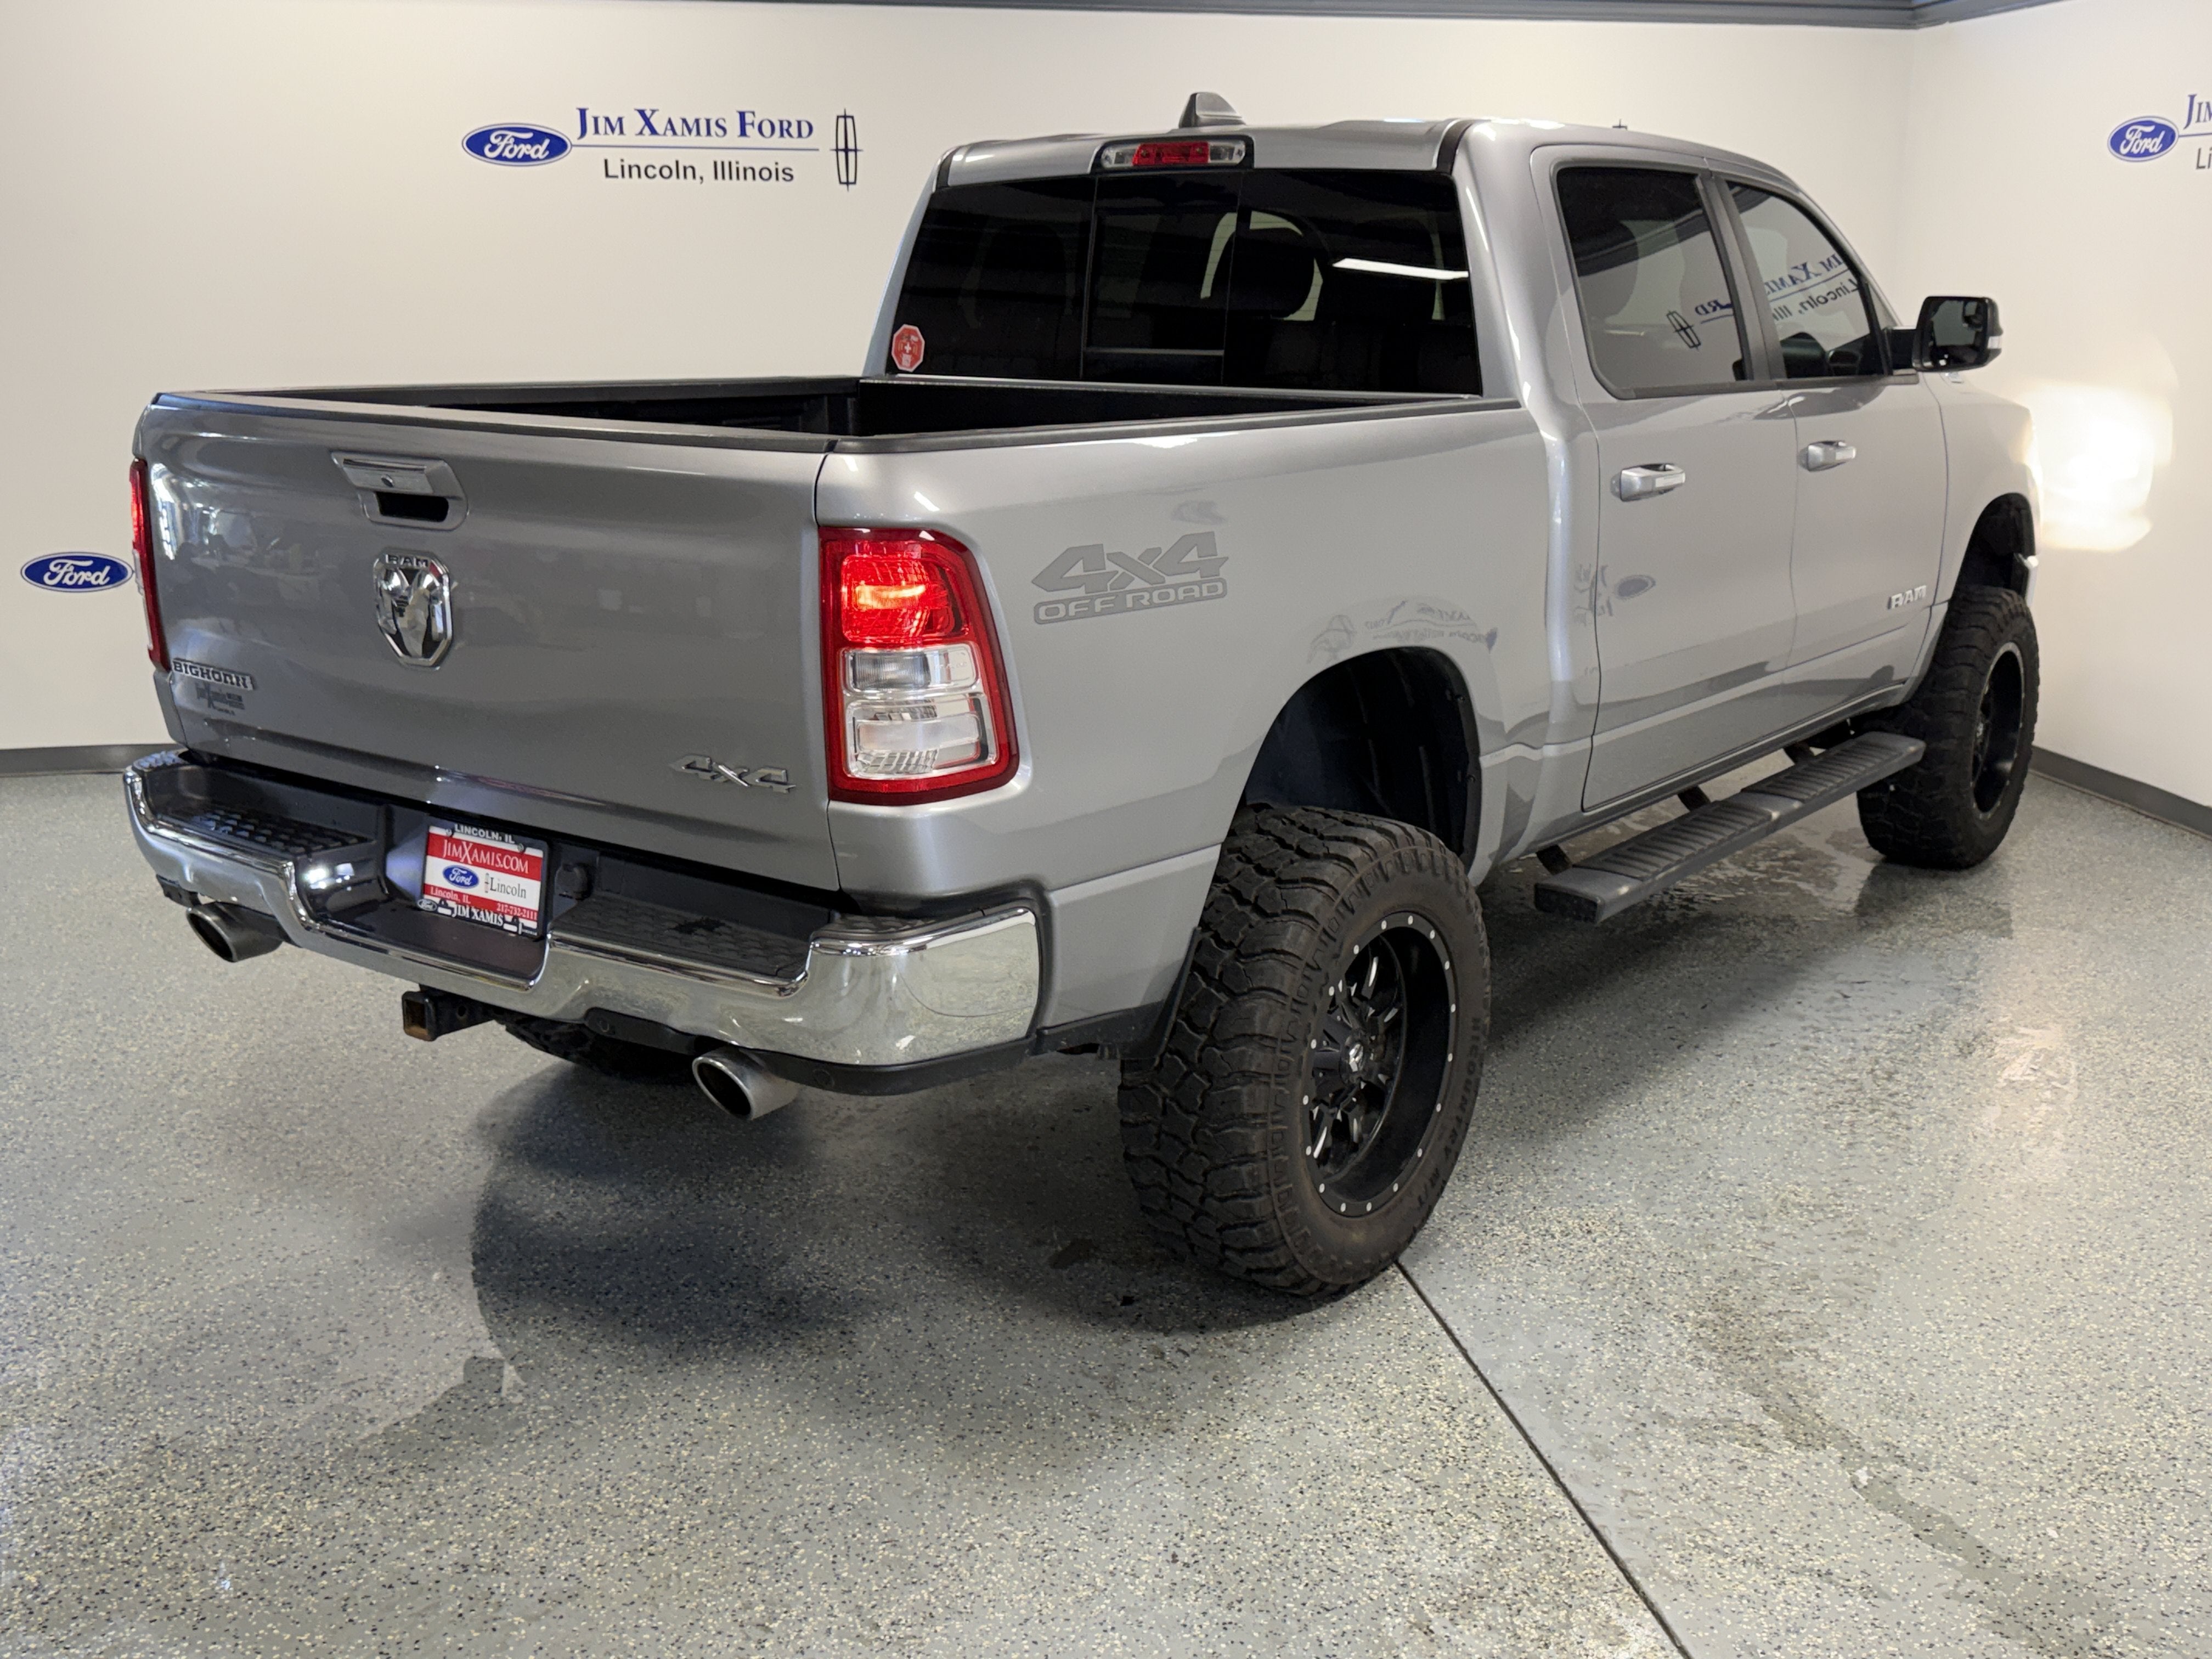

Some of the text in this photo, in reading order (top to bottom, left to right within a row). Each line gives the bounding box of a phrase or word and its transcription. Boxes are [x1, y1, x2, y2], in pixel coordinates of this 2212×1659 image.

[576, 108, 814, 140] JIM XAMIS FORD
[483, 130, 550, 160] Ford
[2120, 125, 2165, 155] Ford
[604, 159, 794, 184] Lincoln, Illinois
[43, 558, 111, 585] Ford
[385, 554, 428, 568] RAM
[1039, 582, 1224, 621] OFF ROAD
[1890, 585, 1927, 608] RAM
[455, 823, 515, 844] LINCOLN, IL
[430, 886, 471, 904] Lincoln, IL
[449, 868, 527, 899] Ford Lincoln
[452, 903, 470, 918] JIM
[472, 906, 504, 927] XAMIS
[496, 902, 538, 921] 217-732-2111
